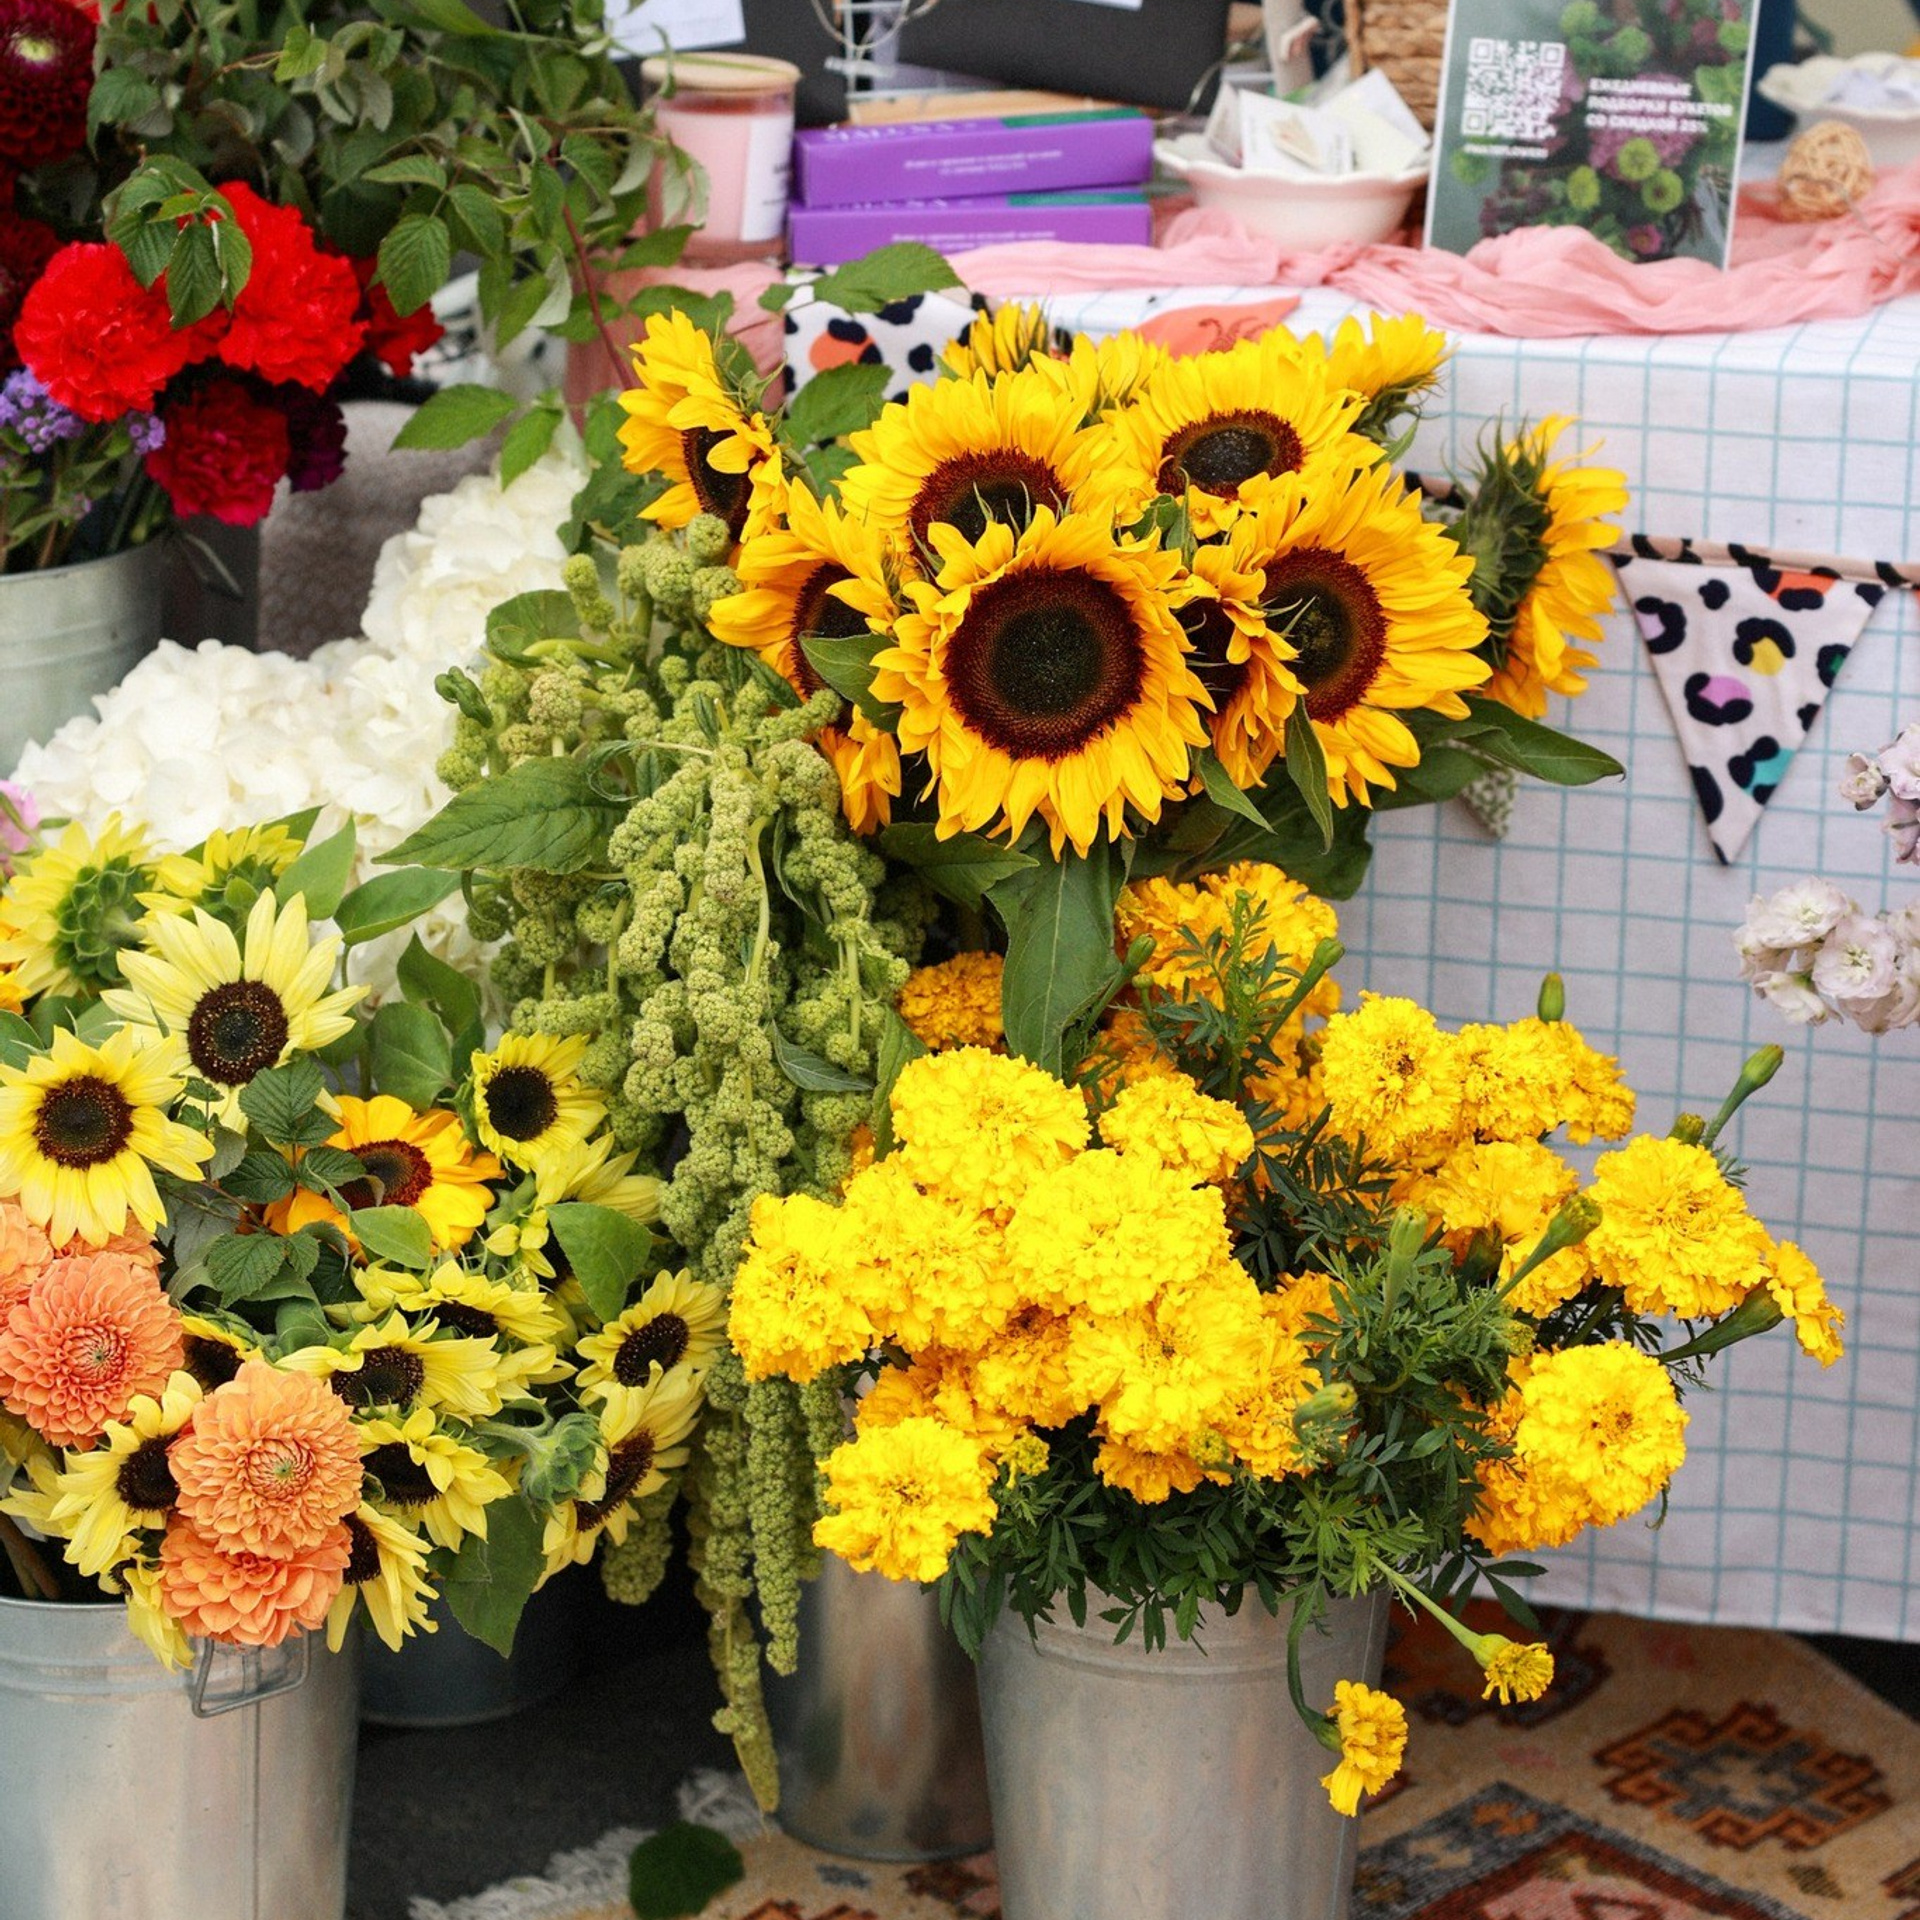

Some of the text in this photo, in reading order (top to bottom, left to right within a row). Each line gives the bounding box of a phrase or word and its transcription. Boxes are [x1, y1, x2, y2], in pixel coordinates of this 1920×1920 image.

[1589, 78, 1692, 96] ЕЖЕДНЕВНЫЕ
[1586, 95, 1733, 117] ПОДБОРКИ БУКЕТОВ
[1585, 113, 1607, 127] СО
[1608, 114, 1678, 132] СКИДКОЙ
